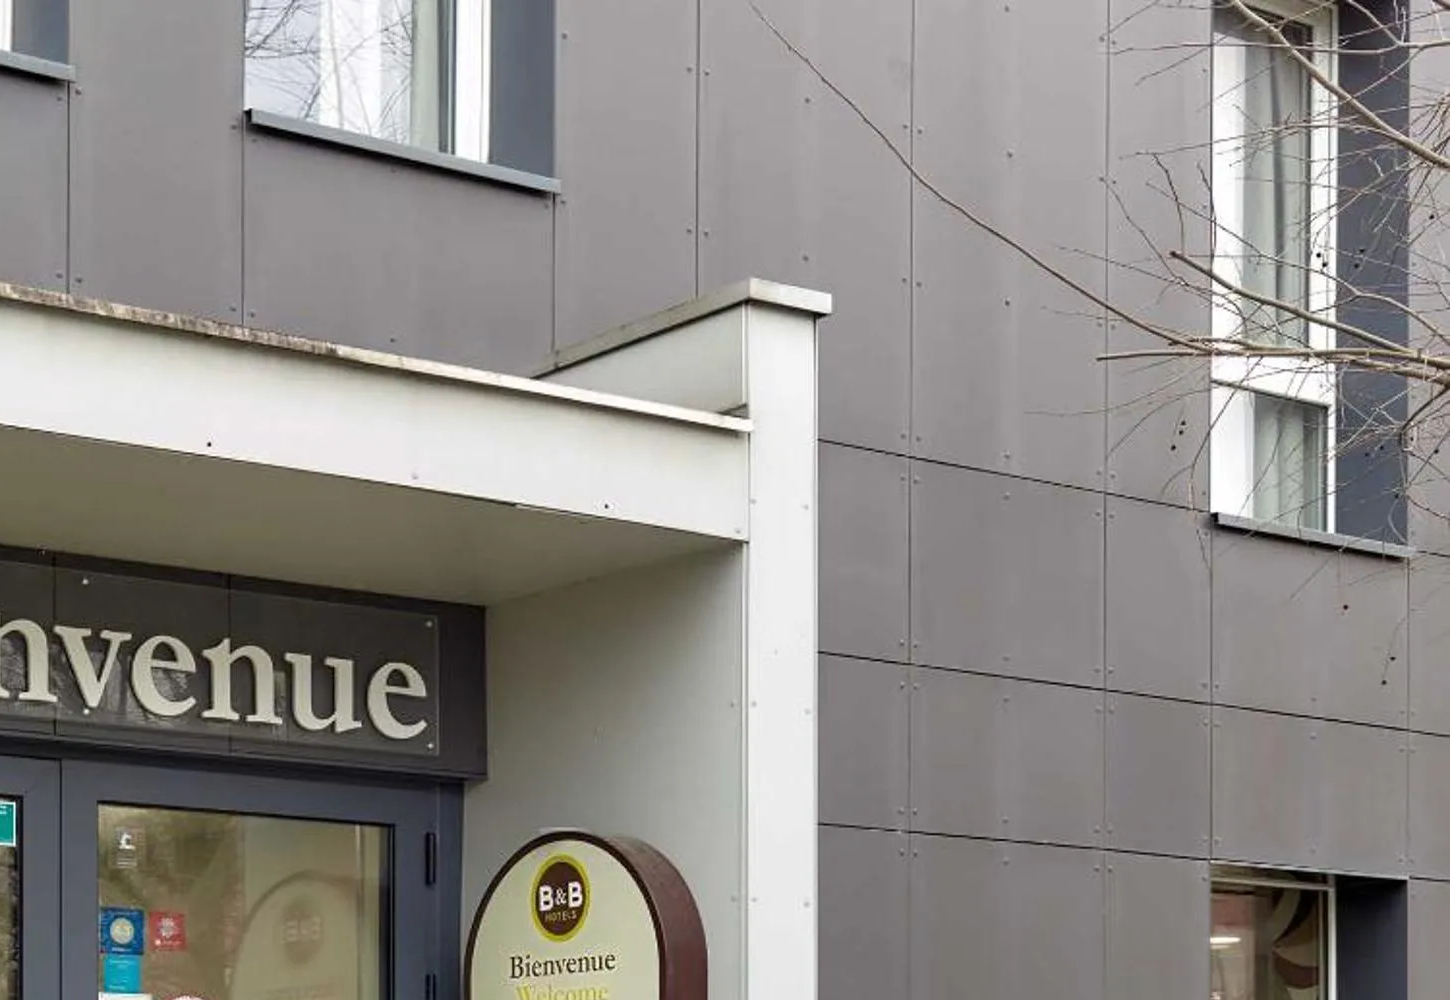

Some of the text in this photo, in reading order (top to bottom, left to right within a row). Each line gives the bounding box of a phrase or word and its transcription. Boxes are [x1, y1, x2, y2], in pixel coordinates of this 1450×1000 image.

[539, 881, 583, 912] B&B
[545, 910, 577, 923] HOTELS
[510, 953, 616, 979] Bienvenue
